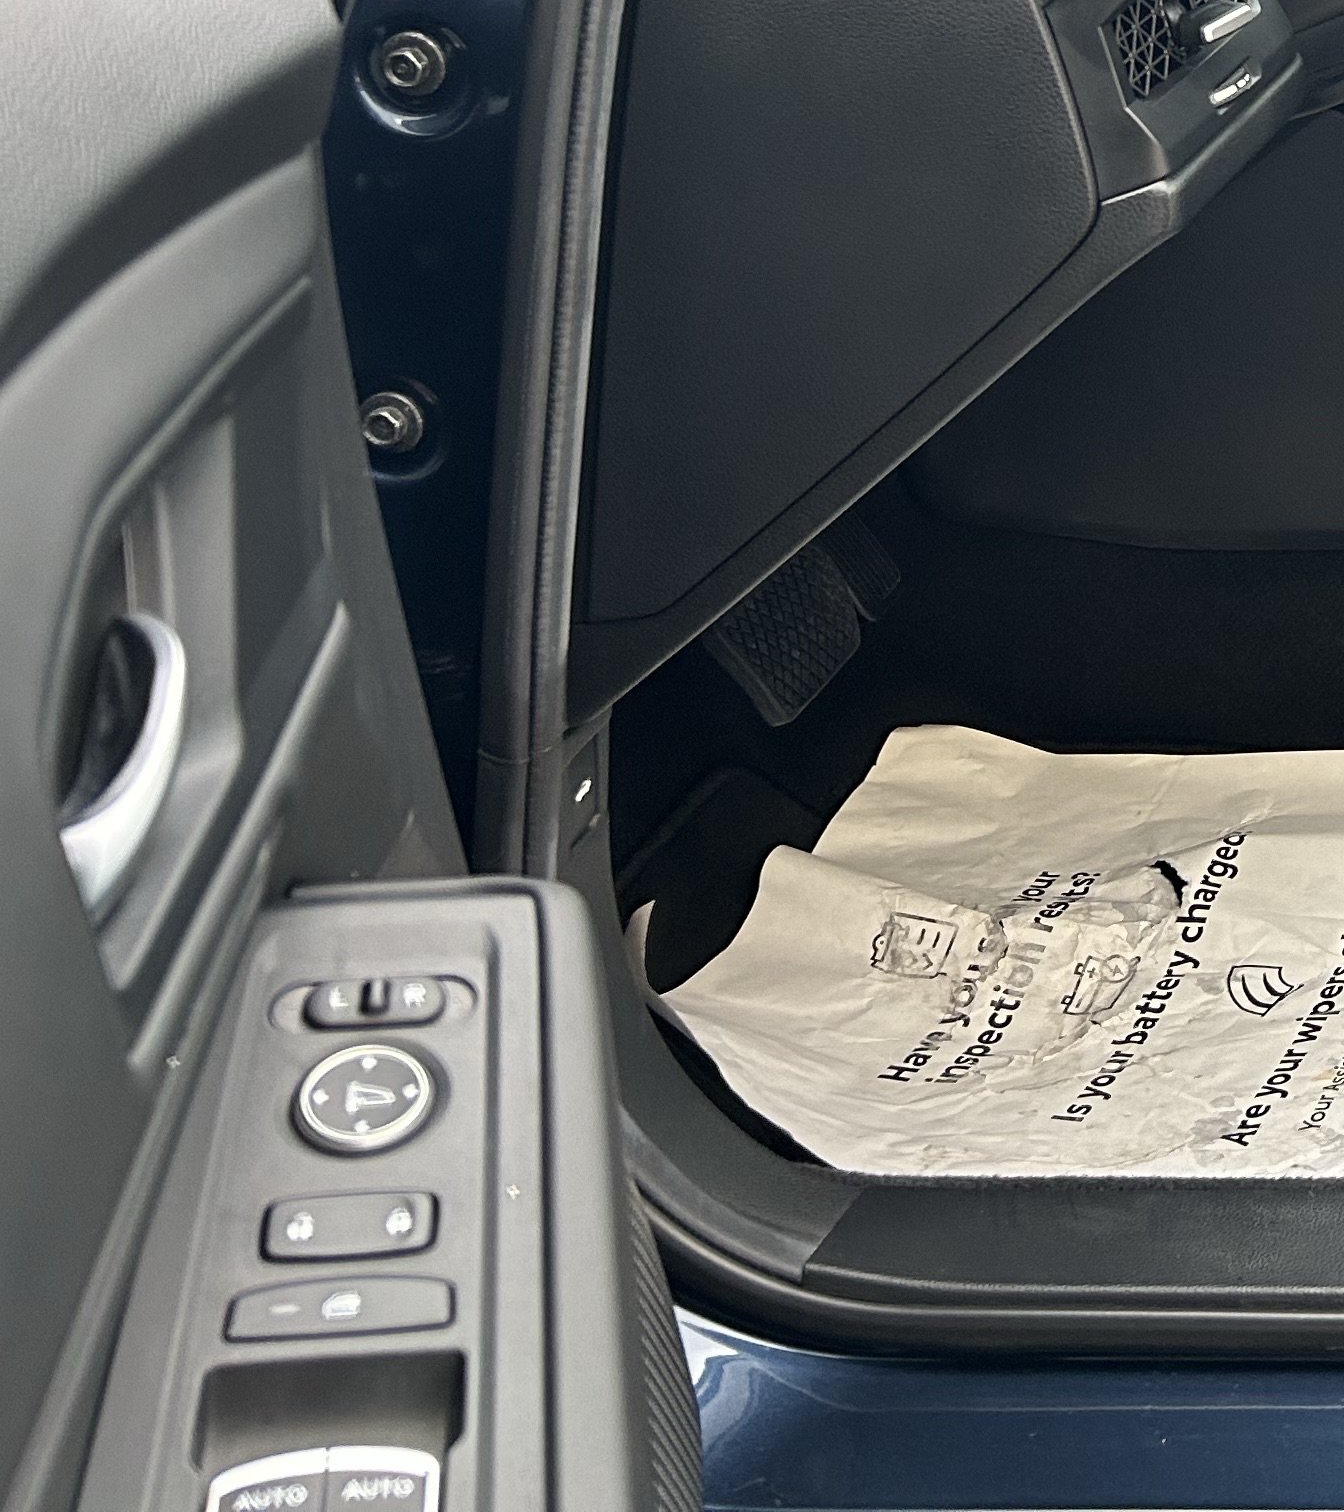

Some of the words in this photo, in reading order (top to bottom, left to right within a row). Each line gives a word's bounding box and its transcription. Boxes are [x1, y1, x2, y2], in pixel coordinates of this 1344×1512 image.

[1011, 871, 1061, 908] your
[1051, 1104, 1092, 1122] Is
[1077, 1050, 1134, 1100] your
[1111, 950, 1200, 1045] battery
[1221, 1104, 1271, 1146] Are
[1254, 1049, 1308, 1098] your
[1298, 1095, 1334, 1131] Your
[341, 1478, 415, 1502] AUTO
